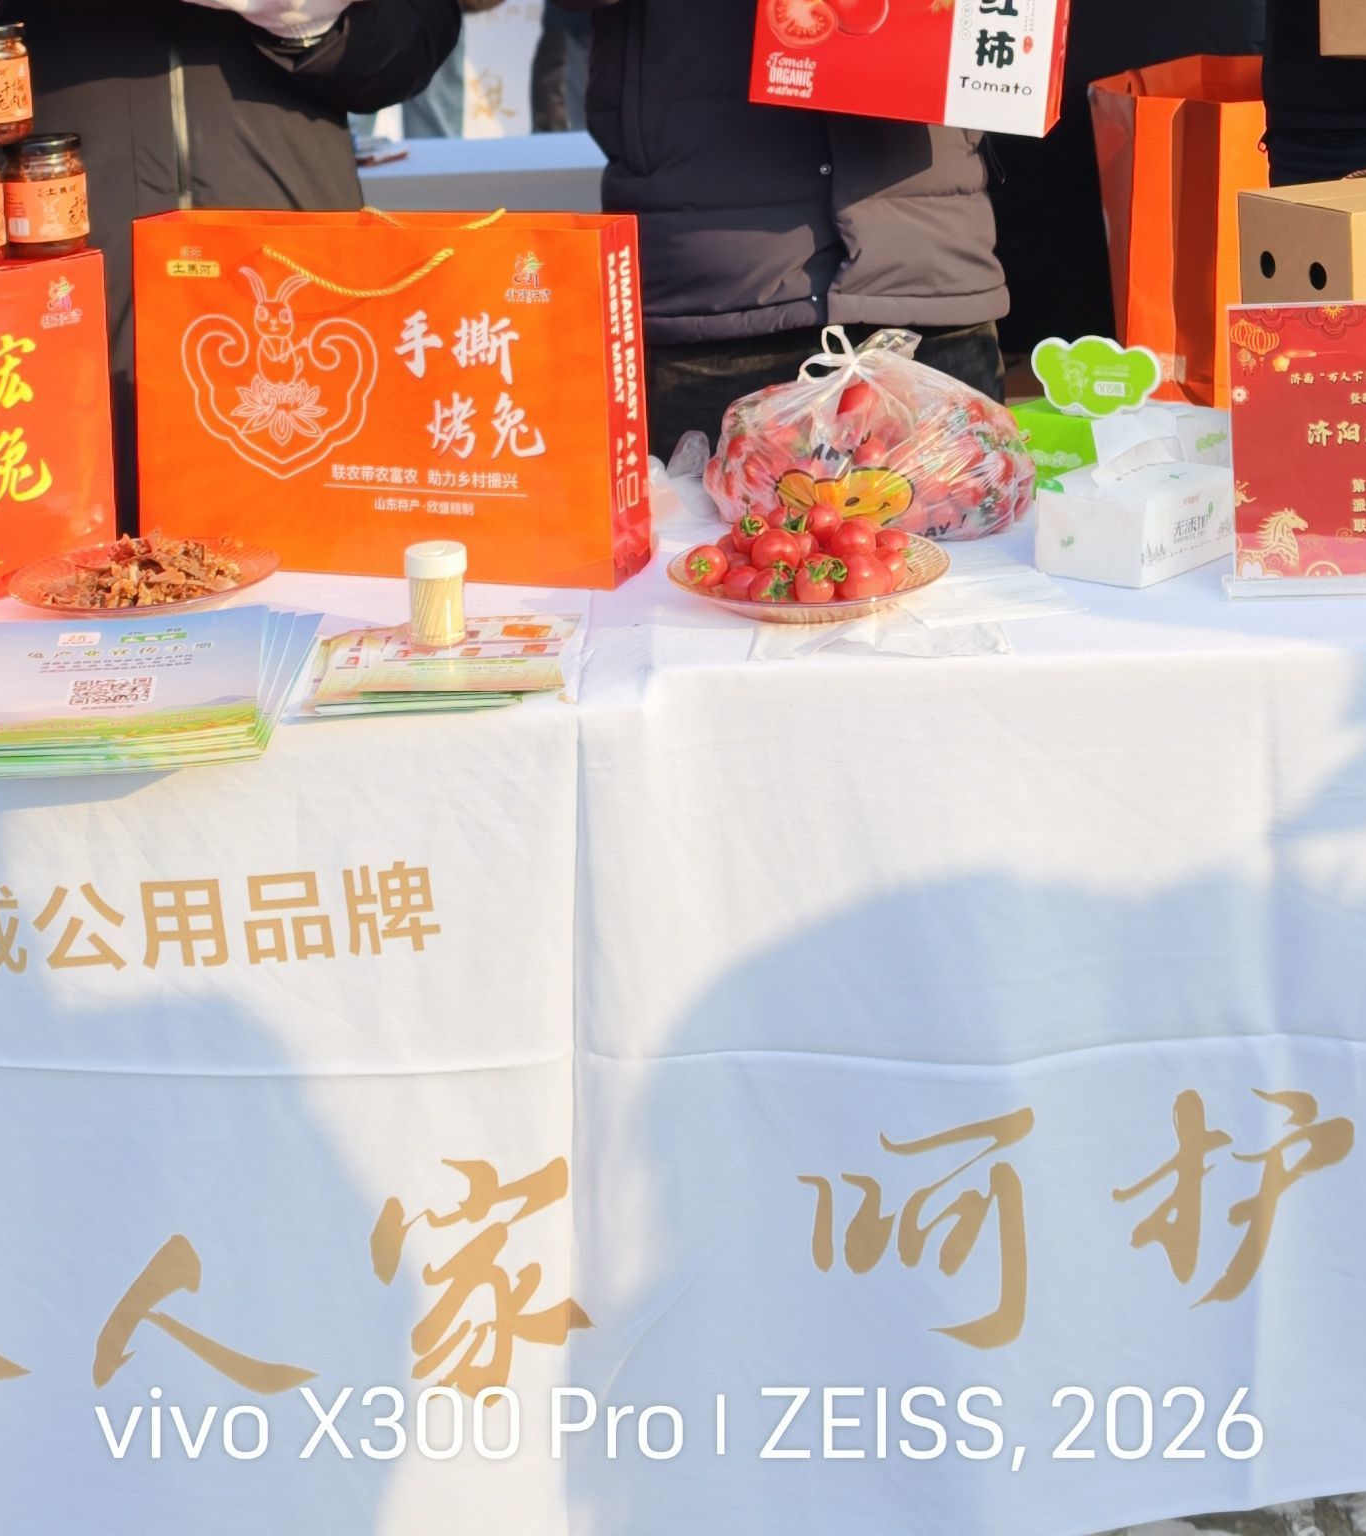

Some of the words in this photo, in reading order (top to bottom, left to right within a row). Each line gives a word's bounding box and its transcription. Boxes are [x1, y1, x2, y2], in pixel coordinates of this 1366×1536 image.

[959, 75, 1033, 97] Tomato
[393, 309, 520, 386] 手撕
[426, 391, 547, 461] 烤兔
[331, 463, 419, 486] 联农带农富农
[427, 466, 518, 491] 助力乡村振兴
